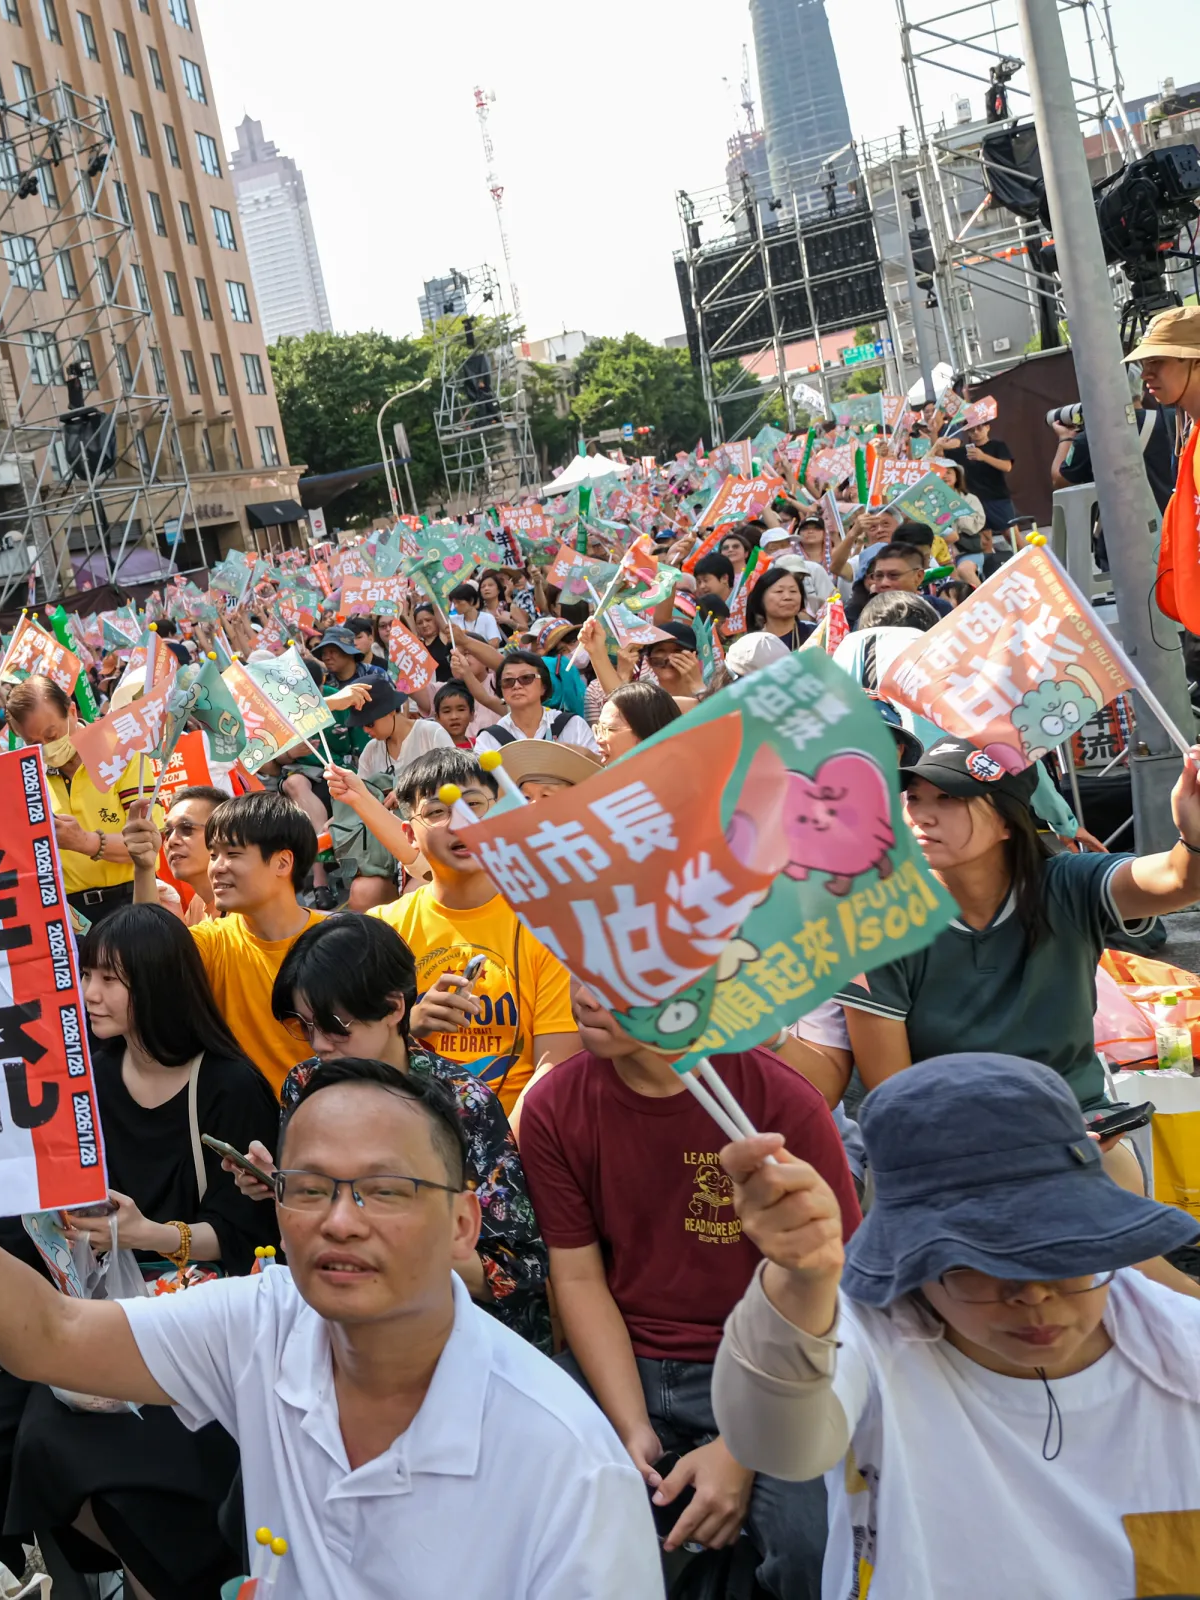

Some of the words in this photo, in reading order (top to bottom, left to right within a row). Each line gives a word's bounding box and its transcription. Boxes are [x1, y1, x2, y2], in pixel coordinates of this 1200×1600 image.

[881, 469, 940, 486] 沈伯
[390, 624, 430, 661] 你的市長
[460, 1035, 502, 1053] DRAFT
[685, 1218, 705, 1232] READ
[705, 1221, 727, 1236] MORE
